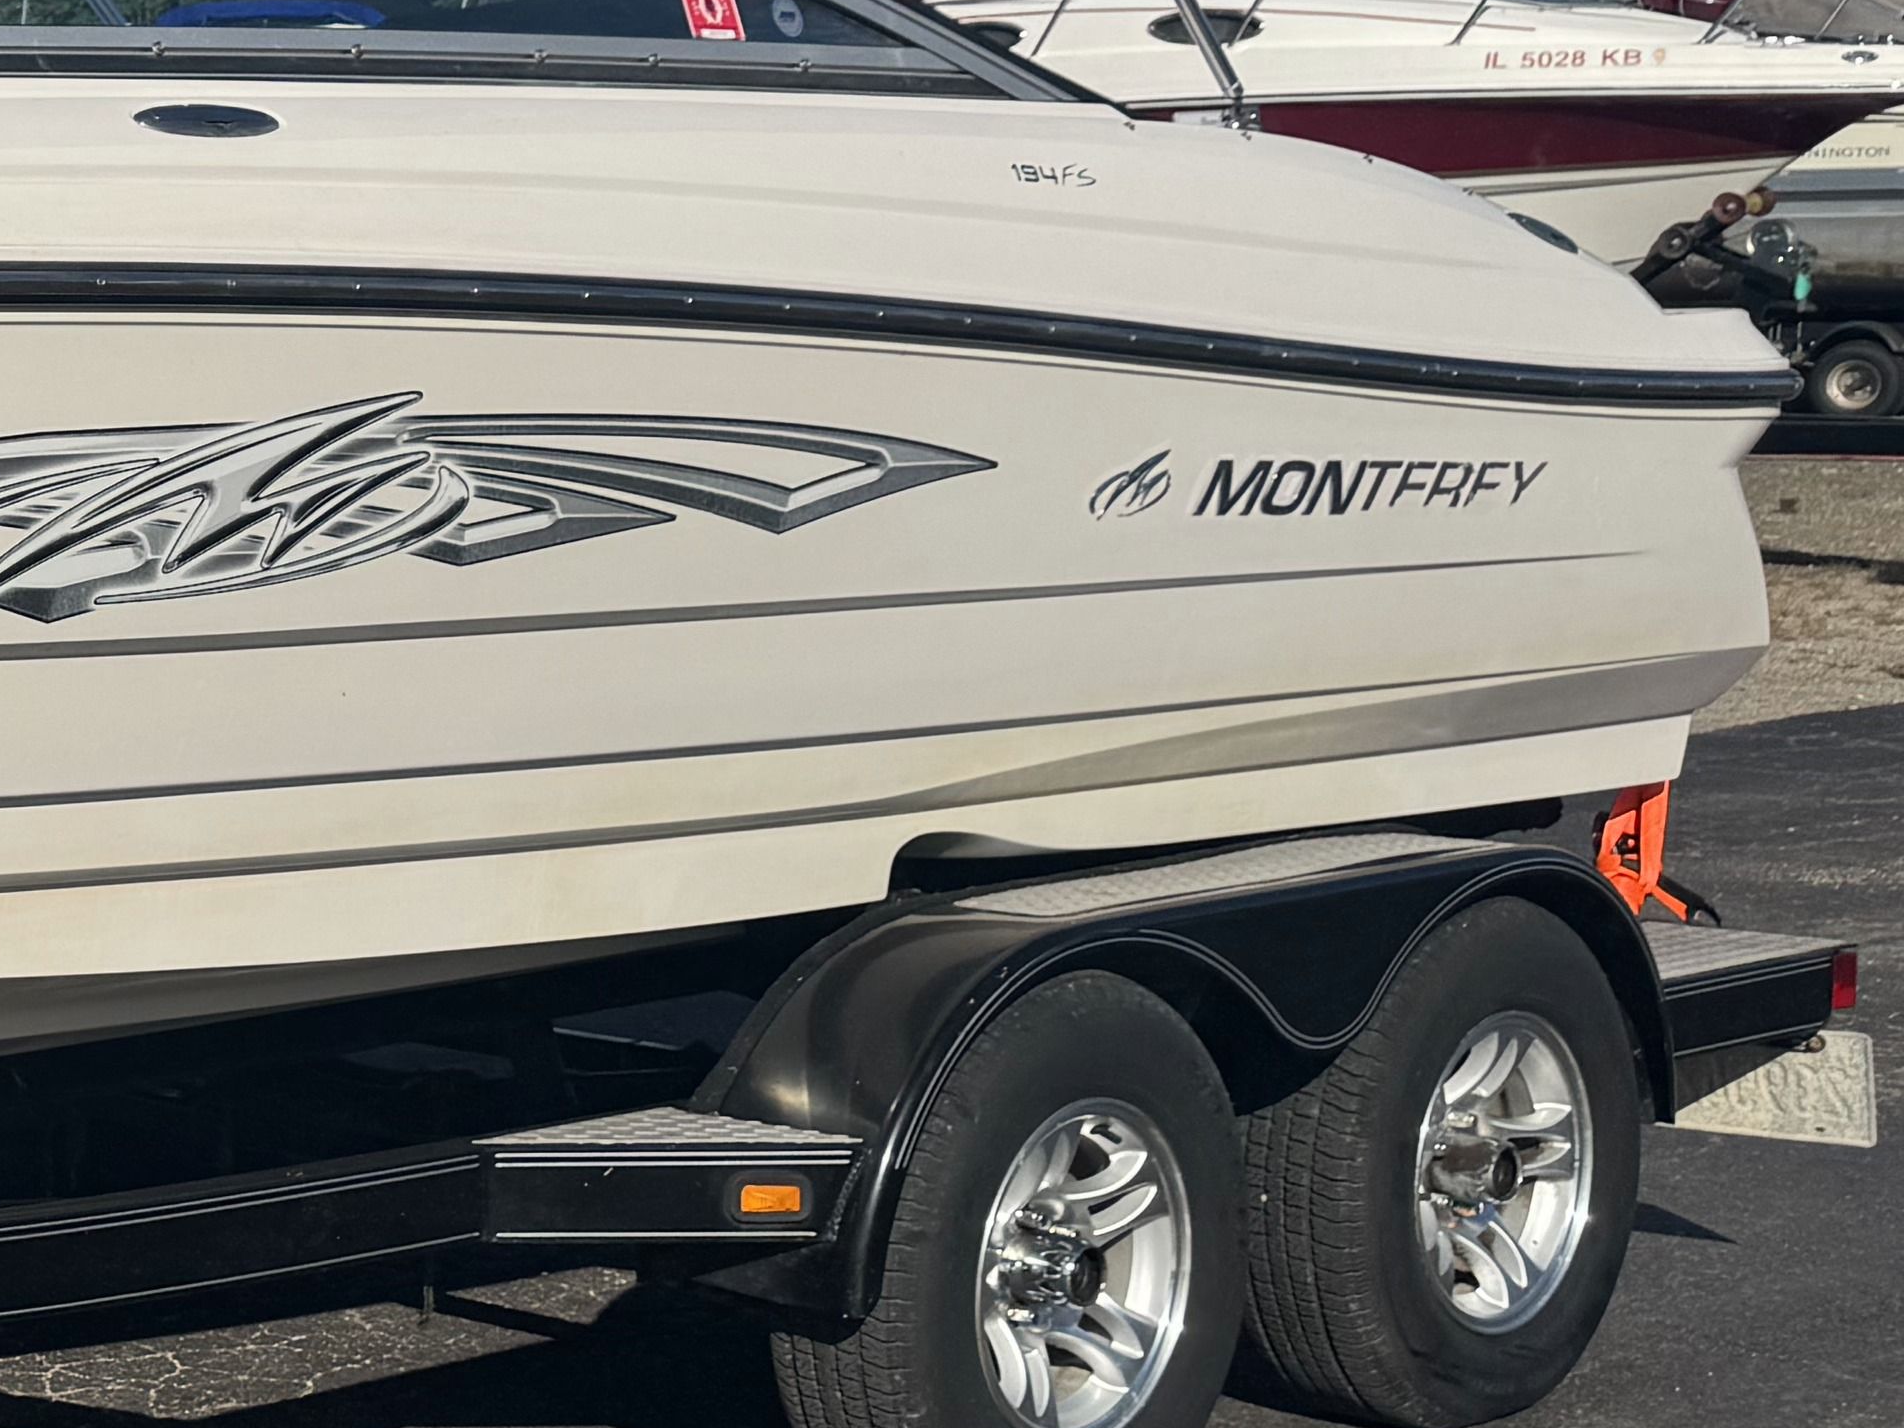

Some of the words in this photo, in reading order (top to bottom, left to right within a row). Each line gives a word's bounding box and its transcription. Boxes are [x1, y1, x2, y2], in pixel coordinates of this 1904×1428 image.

[1483, 51, 1507, 70] IL
[1520, 49, 1586, 69] 5028
[1601, 48, 1642, 67] KB
